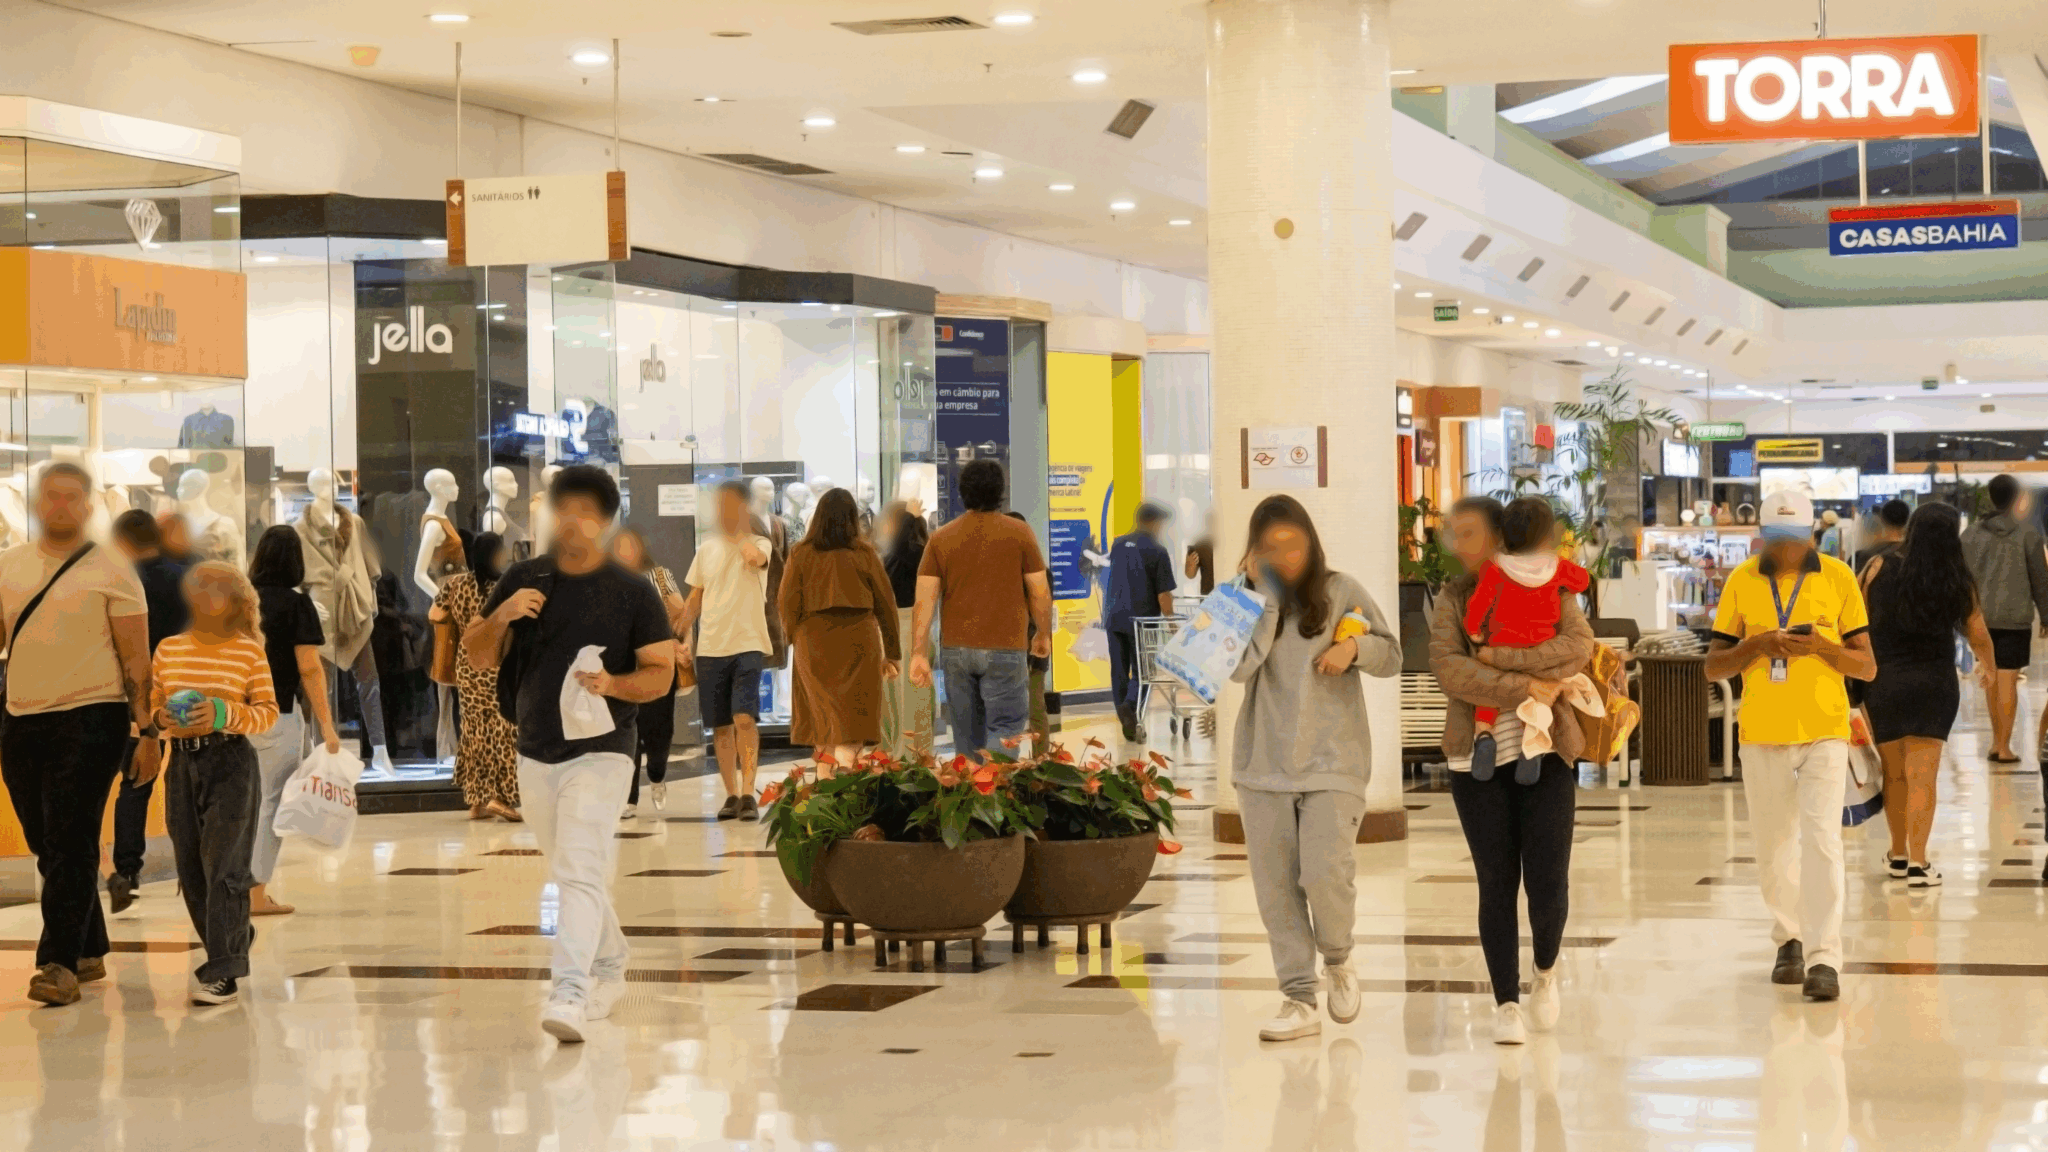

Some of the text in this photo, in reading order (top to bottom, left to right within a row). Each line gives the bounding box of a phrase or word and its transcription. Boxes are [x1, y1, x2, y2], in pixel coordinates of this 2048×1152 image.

[1695, 53, 1955, 122] TORRA
[471, 190, 525, 203] SANITÁRIOS
[368, 305, 453, 365] jella
[939, 389, 952, 397] em
[953, 386, 981, 398] câmbio
[983, 389, 1000, 399] para
[944, 401, 978, 411] empresa
